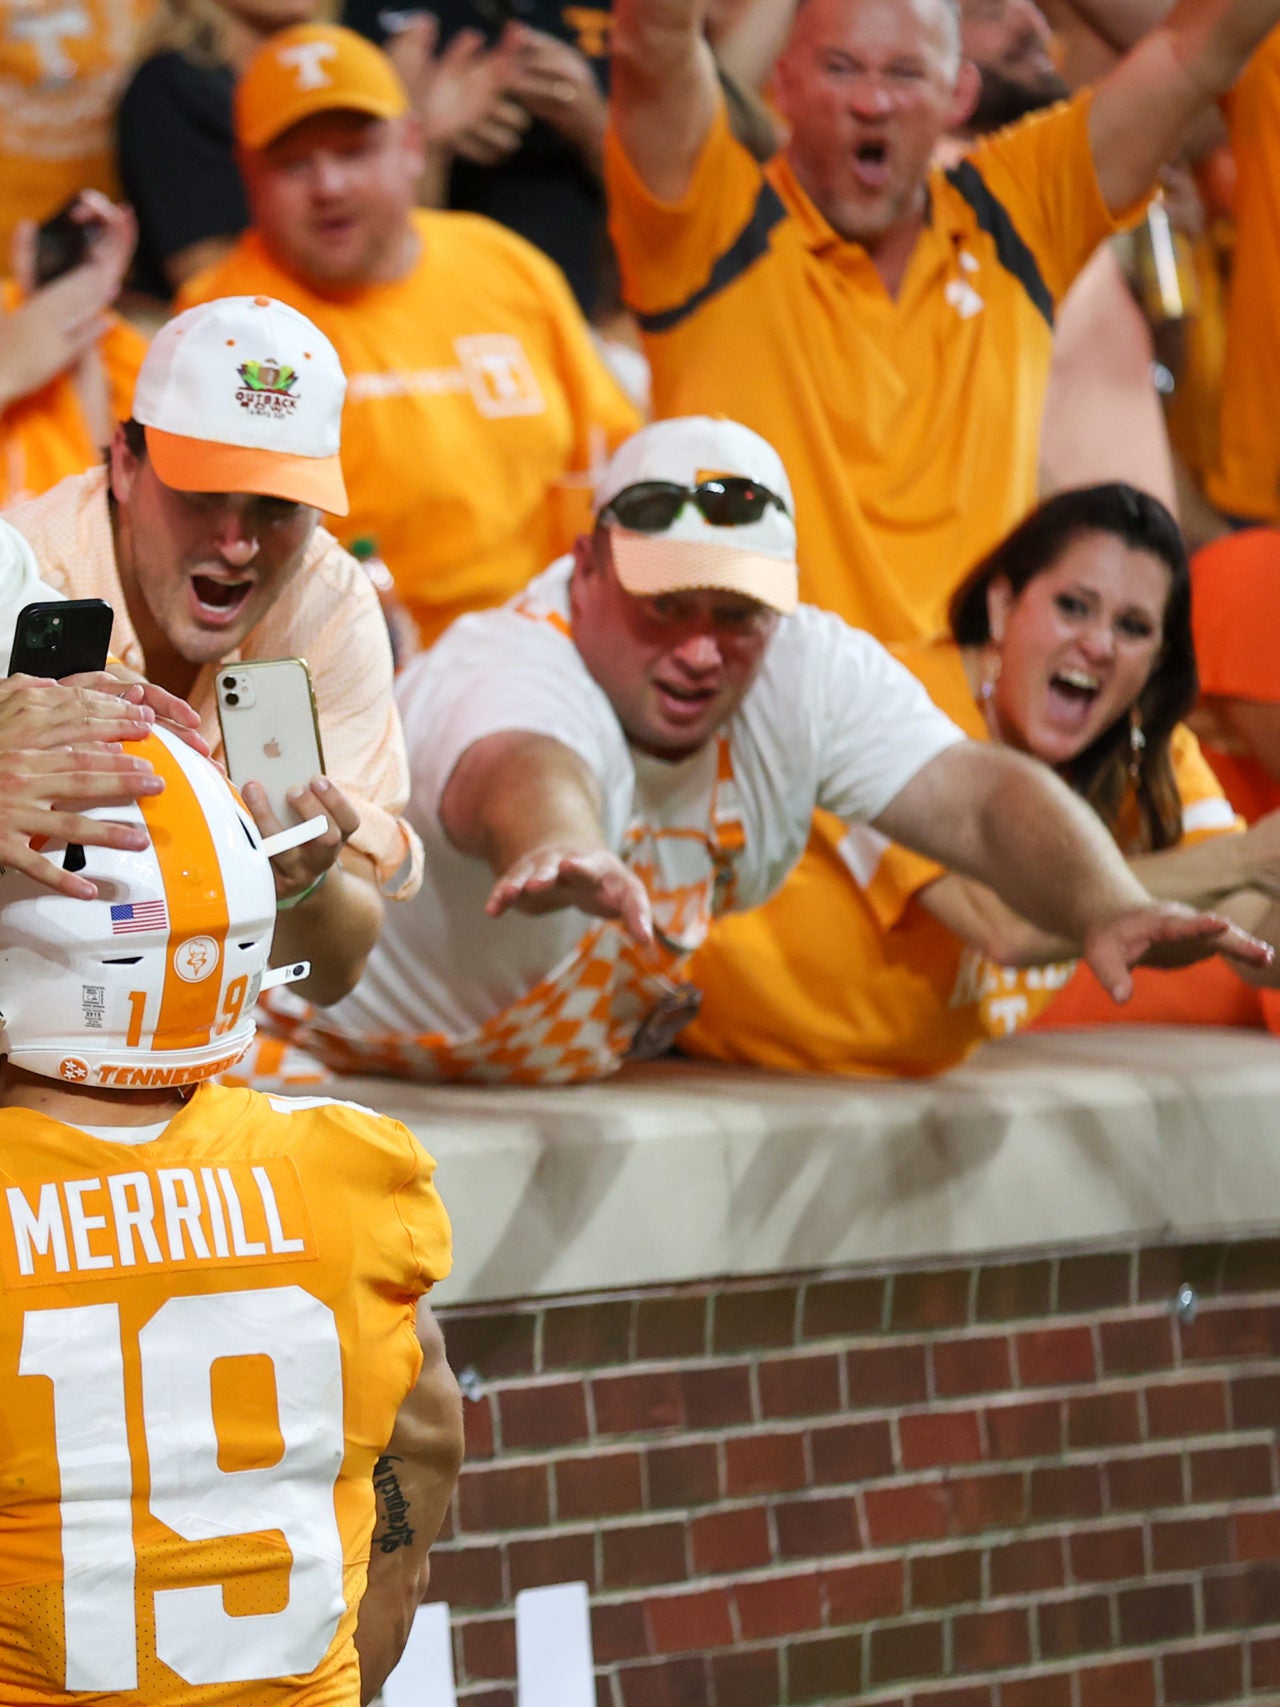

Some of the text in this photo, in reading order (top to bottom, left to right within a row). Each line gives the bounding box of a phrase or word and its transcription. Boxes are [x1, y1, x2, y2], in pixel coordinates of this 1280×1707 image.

[276, 41, 336, 91] T
[235, 391, 297, 409] OUTBACK
[99, 1051, 245, 1086] TENNESS
[6, 1166, 304, 1275] MERRILL
[18, 1285, 346, 1691] 19
